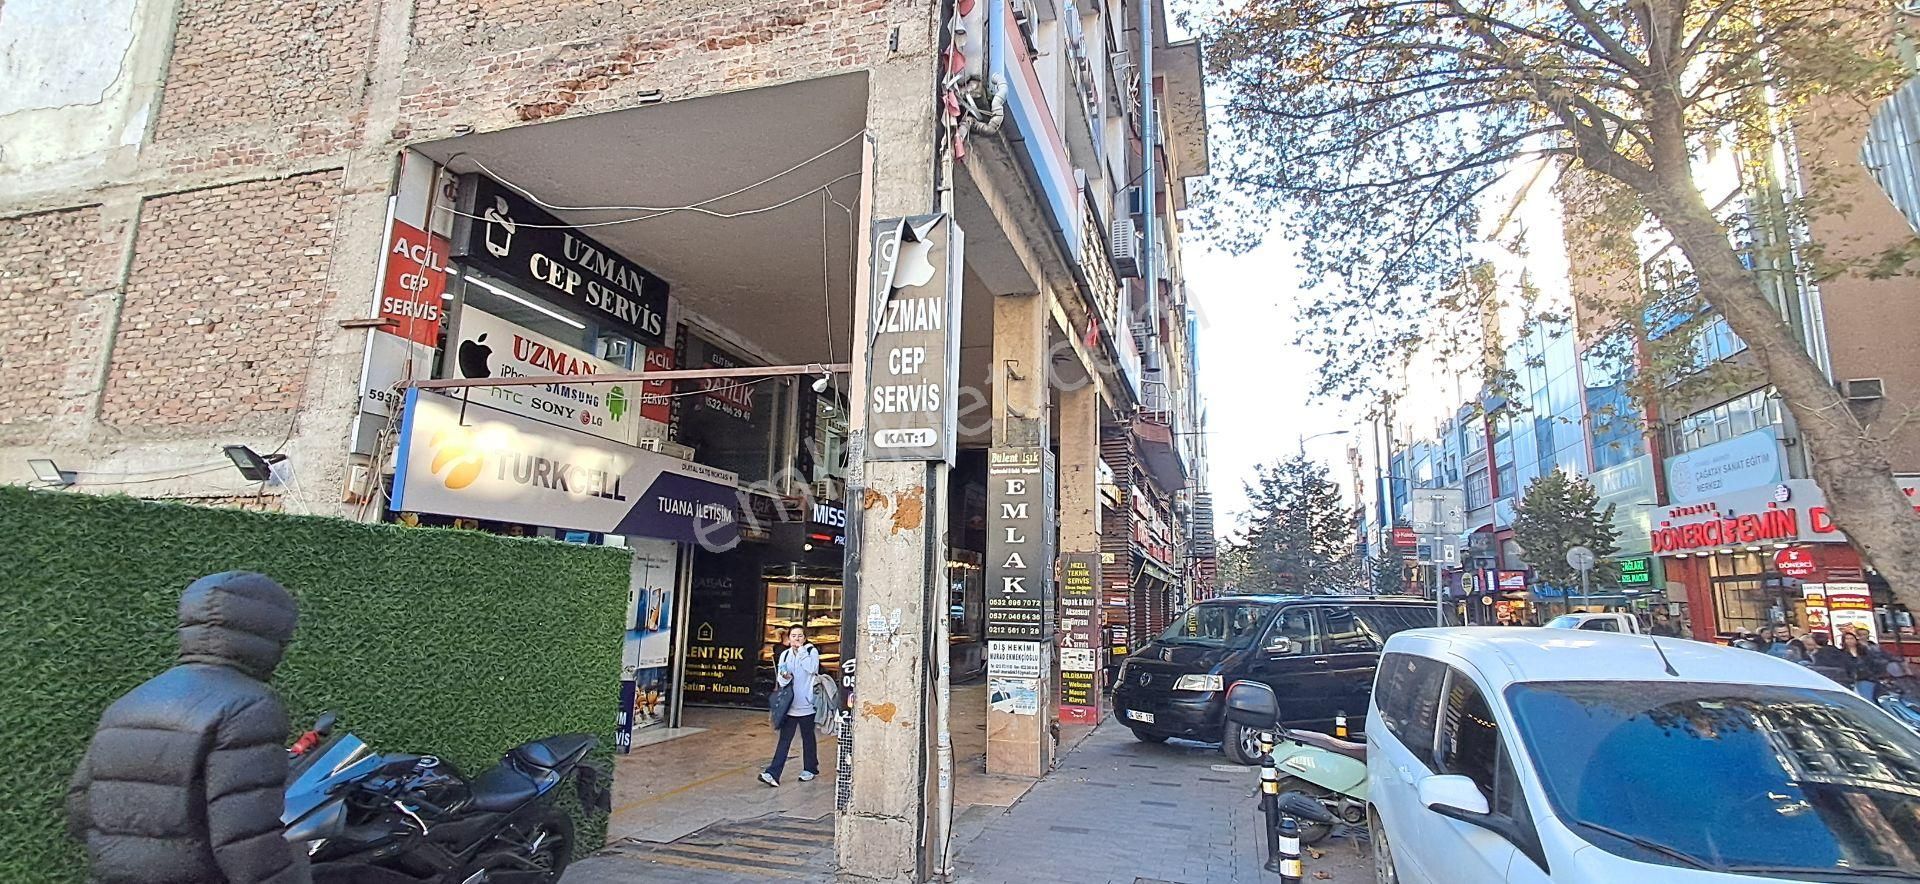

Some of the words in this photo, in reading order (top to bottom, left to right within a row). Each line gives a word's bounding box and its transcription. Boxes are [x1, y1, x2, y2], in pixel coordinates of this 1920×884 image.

[392, 237, 443, 272] ACİL
[562, 231, 646, 298] UZMAN
[400, 273, 429, 292] CEP
[528, 251, 583, 297] CEP
[584, 279, 663, 337] SERVİS
[382, 296, 439, 321] SERVİS
[513, 334, 599, 386] UZMAN
[888, 346, 925, 376] CEP
[872, 378, 940, 414] SERVİS
[530, 397, 576, 419] SONY
[591, 414, 603, 427] LG
[884, 431, 927, 445] KAT:1
[495, 450, 627, 502] TURKCELL
[658, 496, 694, 518] TUANA
[695, 498, 733, 525] İLETİŞİM
[1000, 478, 1029, 594] EMLAK
[1649, 511, 1723, 553] DÖNERCİ
[1737, 501, 1798, 544] EMİN
[1067, 569, 1090, 577] TEKNİK
[1067, 577, 1090, 585] SERVİS
[717, 646, 745, 663] IŞIK
[993, 643, 1006, 652] DİŞ
[1007, 642, 1035, 652] HEKİMİ
[712, 683, 750, 694] Kiralama
